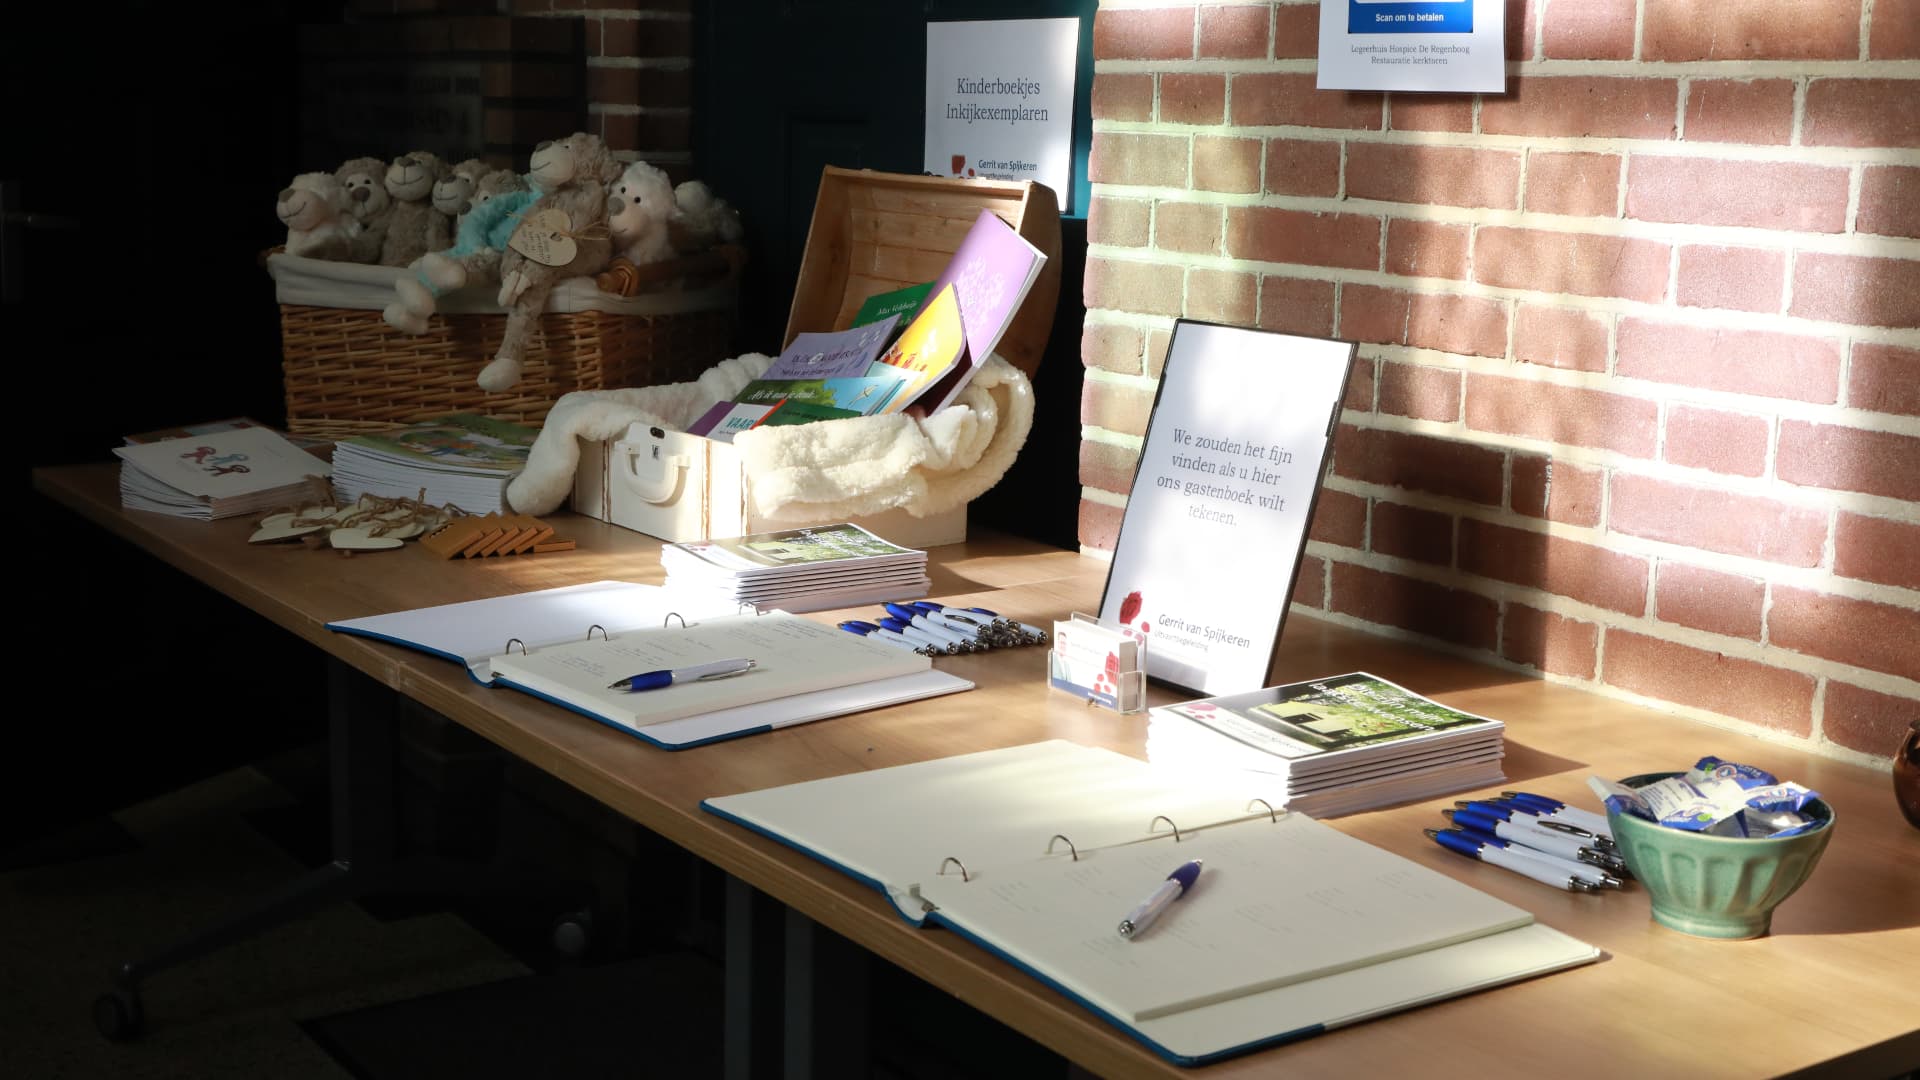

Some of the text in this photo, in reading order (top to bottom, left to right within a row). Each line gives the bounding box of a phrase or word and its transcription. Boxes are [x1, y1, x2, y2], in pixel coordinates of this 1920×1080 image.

[1375, 13, 1444, 22] Scan om te betalen
[1389, 44, 1417, 54] Hospice
[1419, 44, 1429, 53] De
[1431, 44, 1470, 54] Regenboog
[1371, 56, 1410, 65] Restauratie
[957, 78, 1040, 99] Kinderboekjes
[946, 104, 1048, 125] Inkijkexemplaren
[978, 159, 1037, 173] Gerrit van Spijkeren
[1173, 427, 1293, 466] We zouden het fijn
[1172, 454, 1281, 486] vinden als u hier
[1157, 474, 1285, 512] ons gastenboek wilt
[1188, 504, 1237, 526] tekenen.
[1158, 613, 1251, 649] Gerrit van Spijkeren
